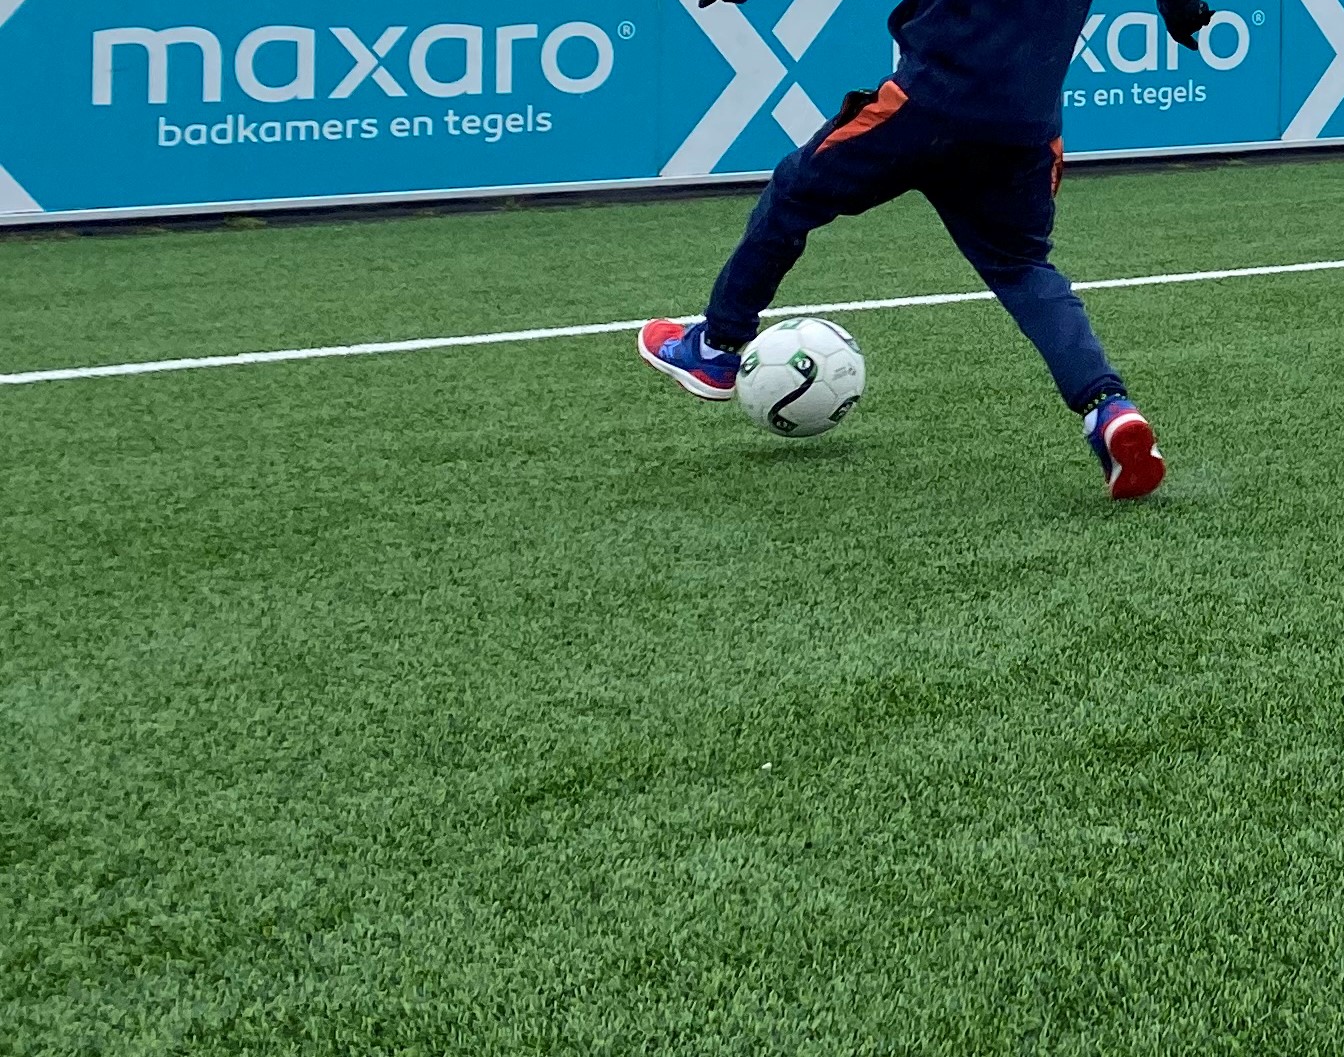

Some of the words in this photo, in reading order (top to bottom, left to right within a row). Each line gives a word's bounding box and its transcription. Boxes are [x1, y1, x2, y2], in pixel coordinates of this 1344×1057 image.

[92, 21, 614, 105] maxaro
[1094, 88, 1123, 106] en
[1131, 79, 1207, 110] tegels
[157, 114, 378, 147] badkamers
[390, 115, 433, 137] en
[444, 104, 552, 142] tegels
